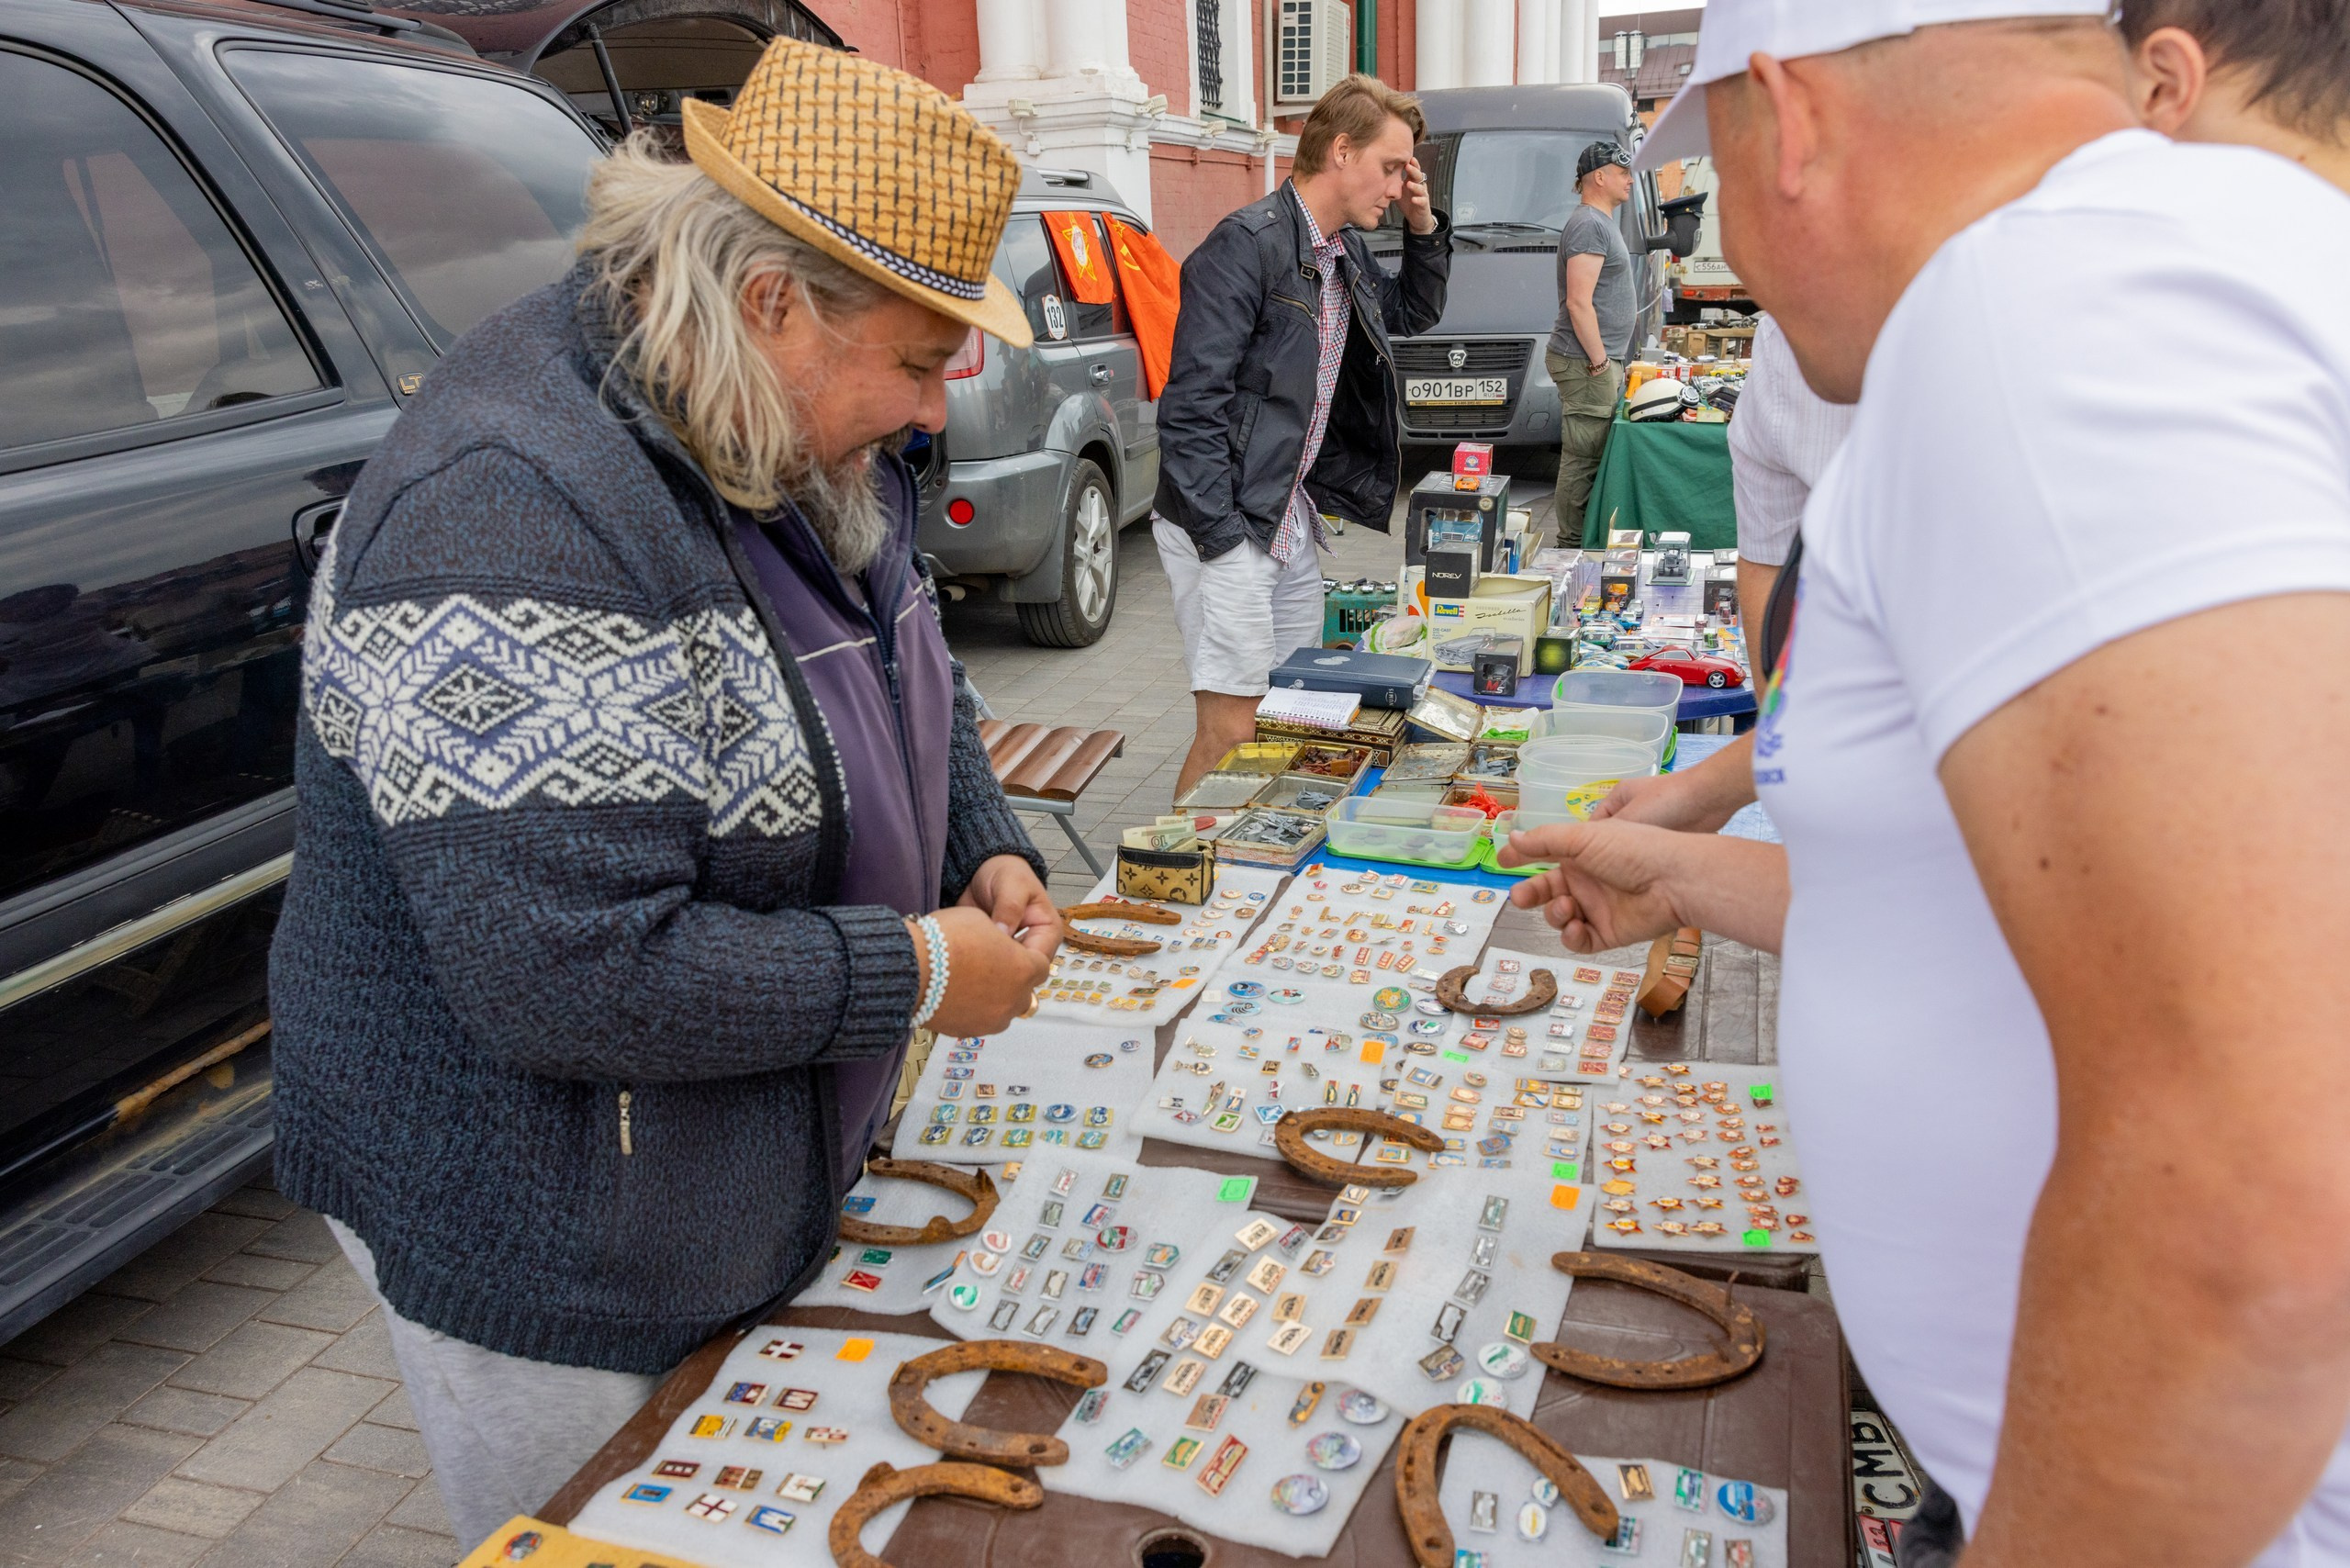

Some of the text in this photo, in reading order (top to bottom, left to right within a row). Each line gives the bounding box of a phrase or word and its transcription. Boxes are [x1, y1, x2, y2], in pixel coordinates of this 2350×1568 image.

[1046, 306, 1064, 329] 132
[1411, 382, 1474, 398] О901ВР
[1479, 380, 1503, 393] 152
[1437, 605, 1458, 615] Revell
